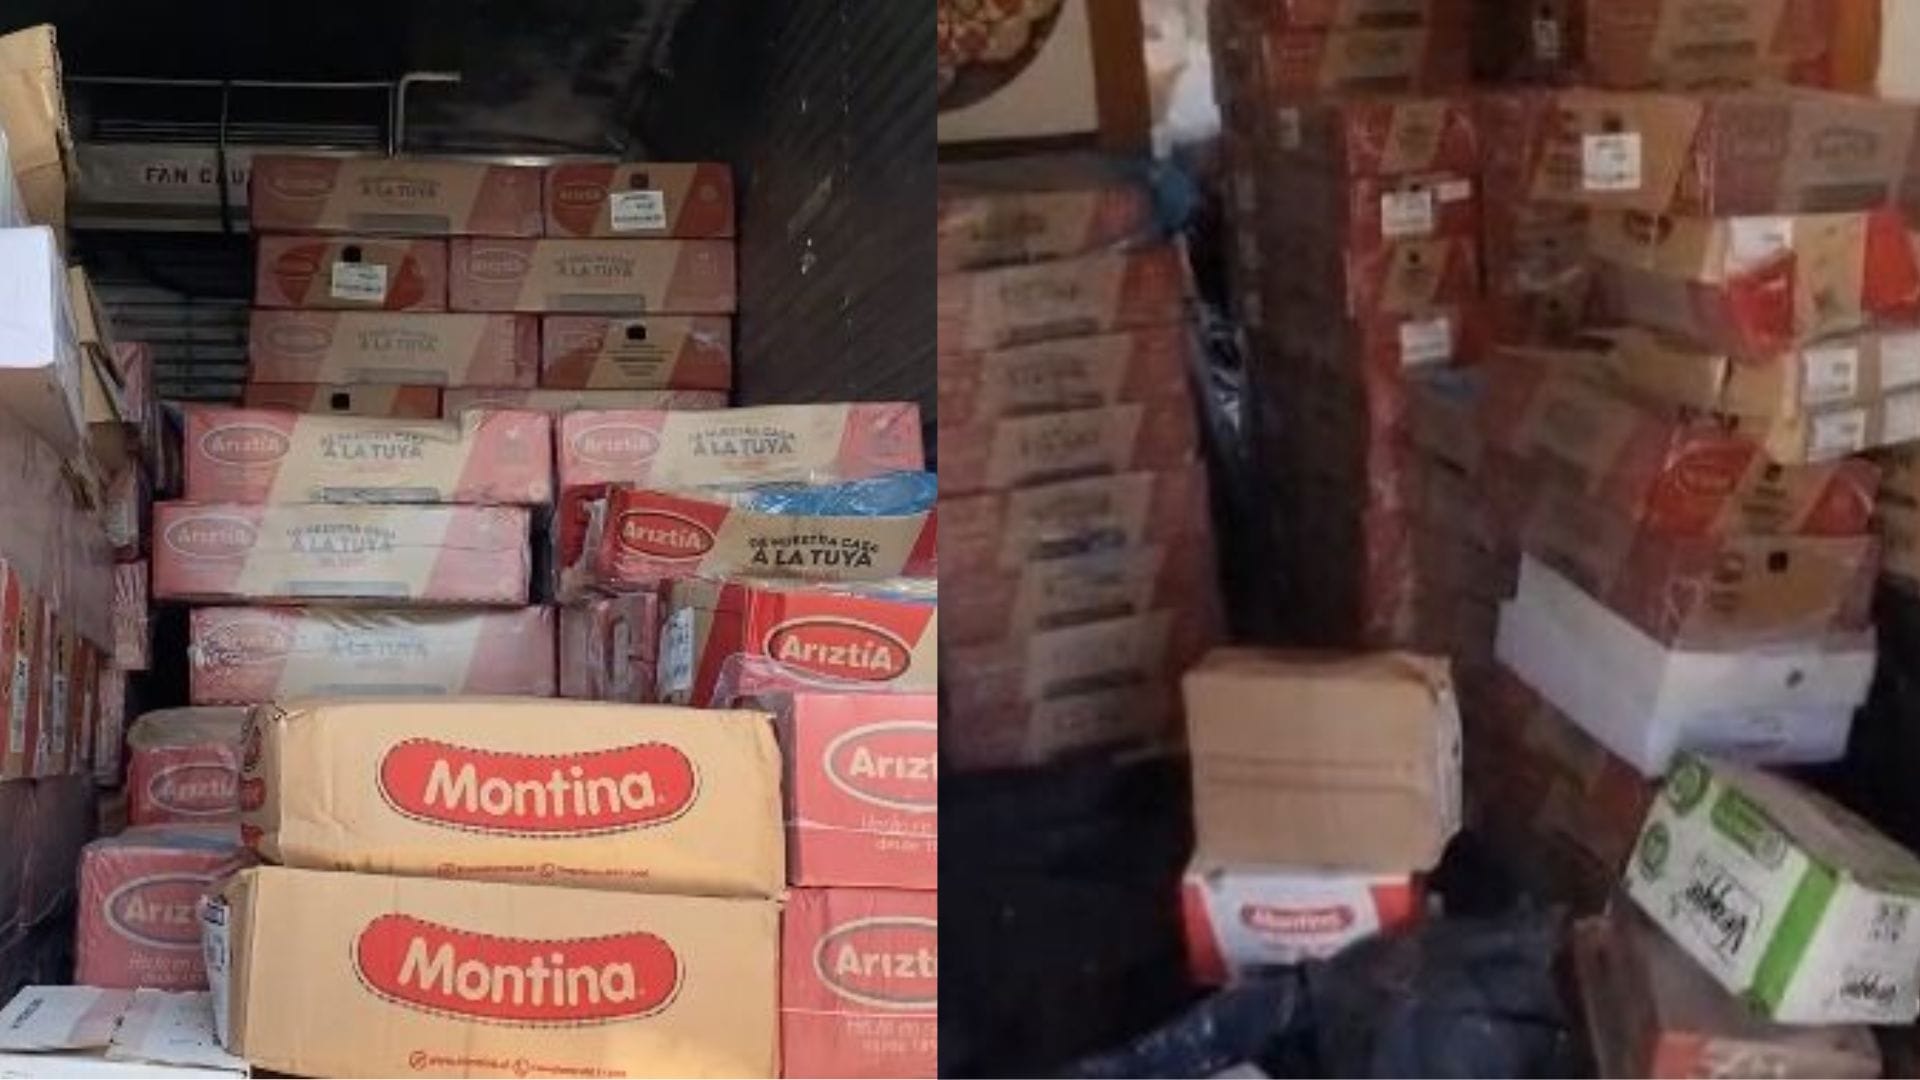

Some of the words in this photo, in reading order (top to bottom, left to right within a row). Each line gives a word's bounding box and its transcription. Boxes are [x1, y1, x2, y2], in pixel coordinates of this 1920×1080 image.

[146, 168, 188, 184] FAN
[373, 443, 424, 460] TUYA
[711, 439, 738, 457] LA
[742, 438, 794, 456] TUYA
[340, 536, 393, 553] TUYA
[752, 550, 769, 566] A
[775, 549, 804, 566] LA
[810, 549, 872, 569] TUYA
[423, 759, 655, 817] Montina
[398, 937, 636, 1006] Montina
